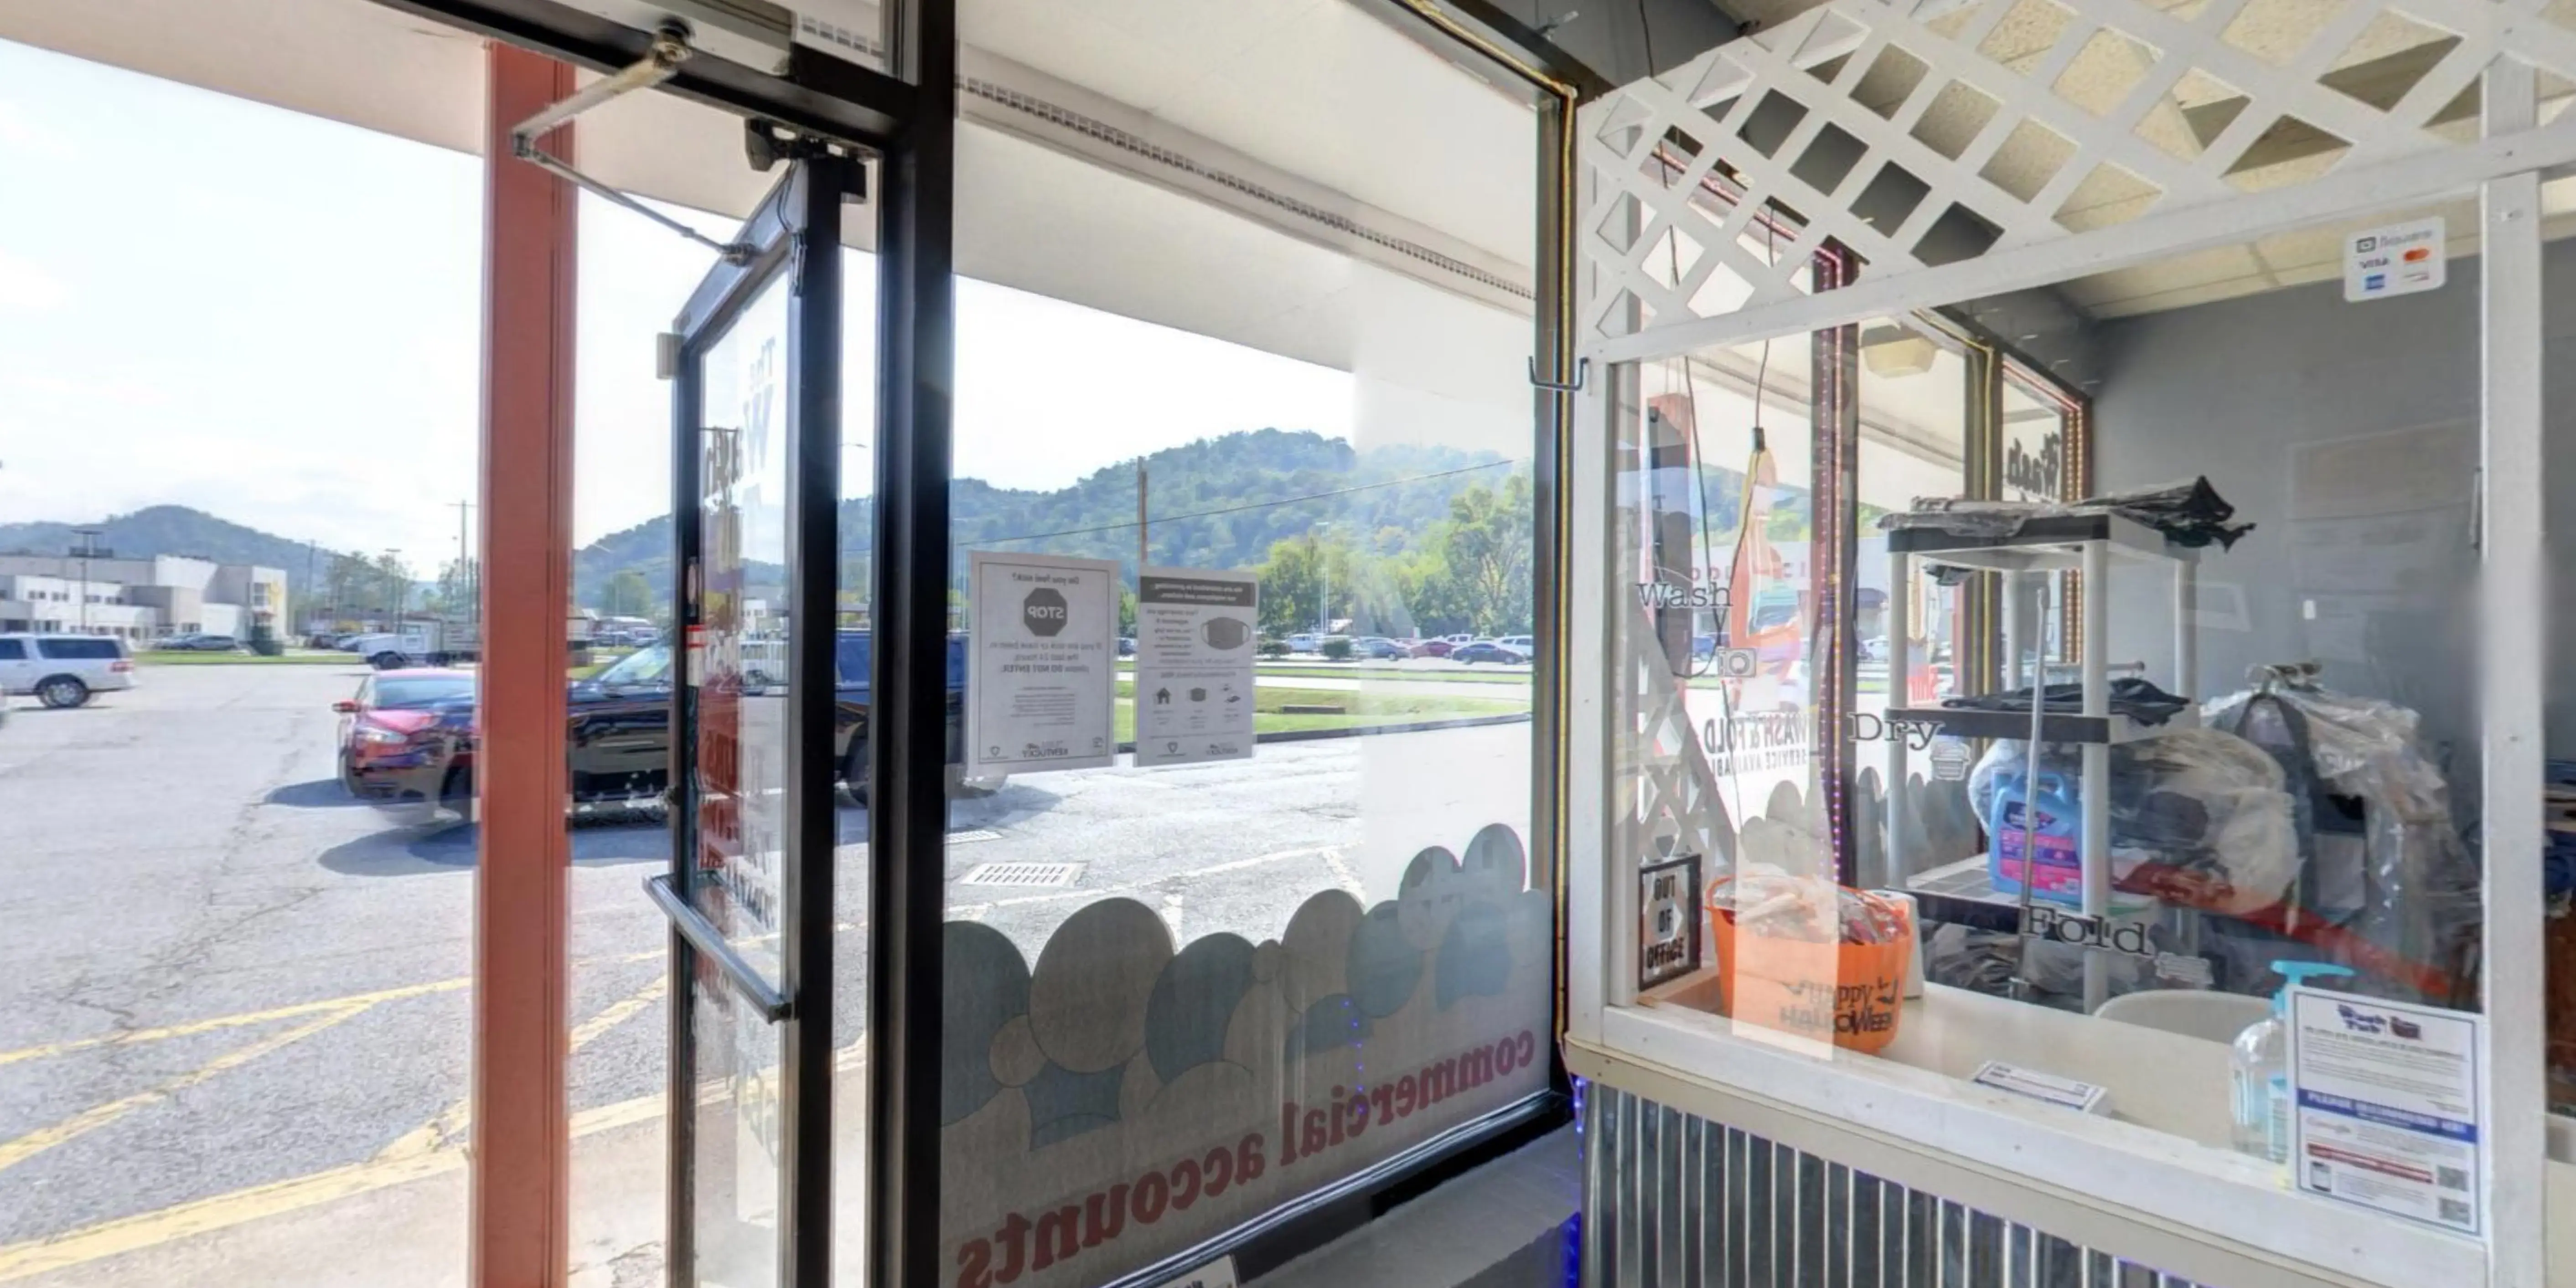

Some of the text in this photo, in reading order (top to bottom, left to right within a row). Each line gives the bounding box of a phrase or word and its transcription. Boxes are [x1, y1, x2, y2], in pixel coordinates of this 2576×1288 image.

[2359, 257, 2390, 269] VISA
[1635, 582, 1733, 607] Wash
[1848, 713, 1944, 750] Dry
[1654, 874, 1676, 901] OUT
[1658, 908, 1672, 933] OF
[2026, 905, 2155, 957] Fold
[1646, 937, 1685, 970] OFFICE
